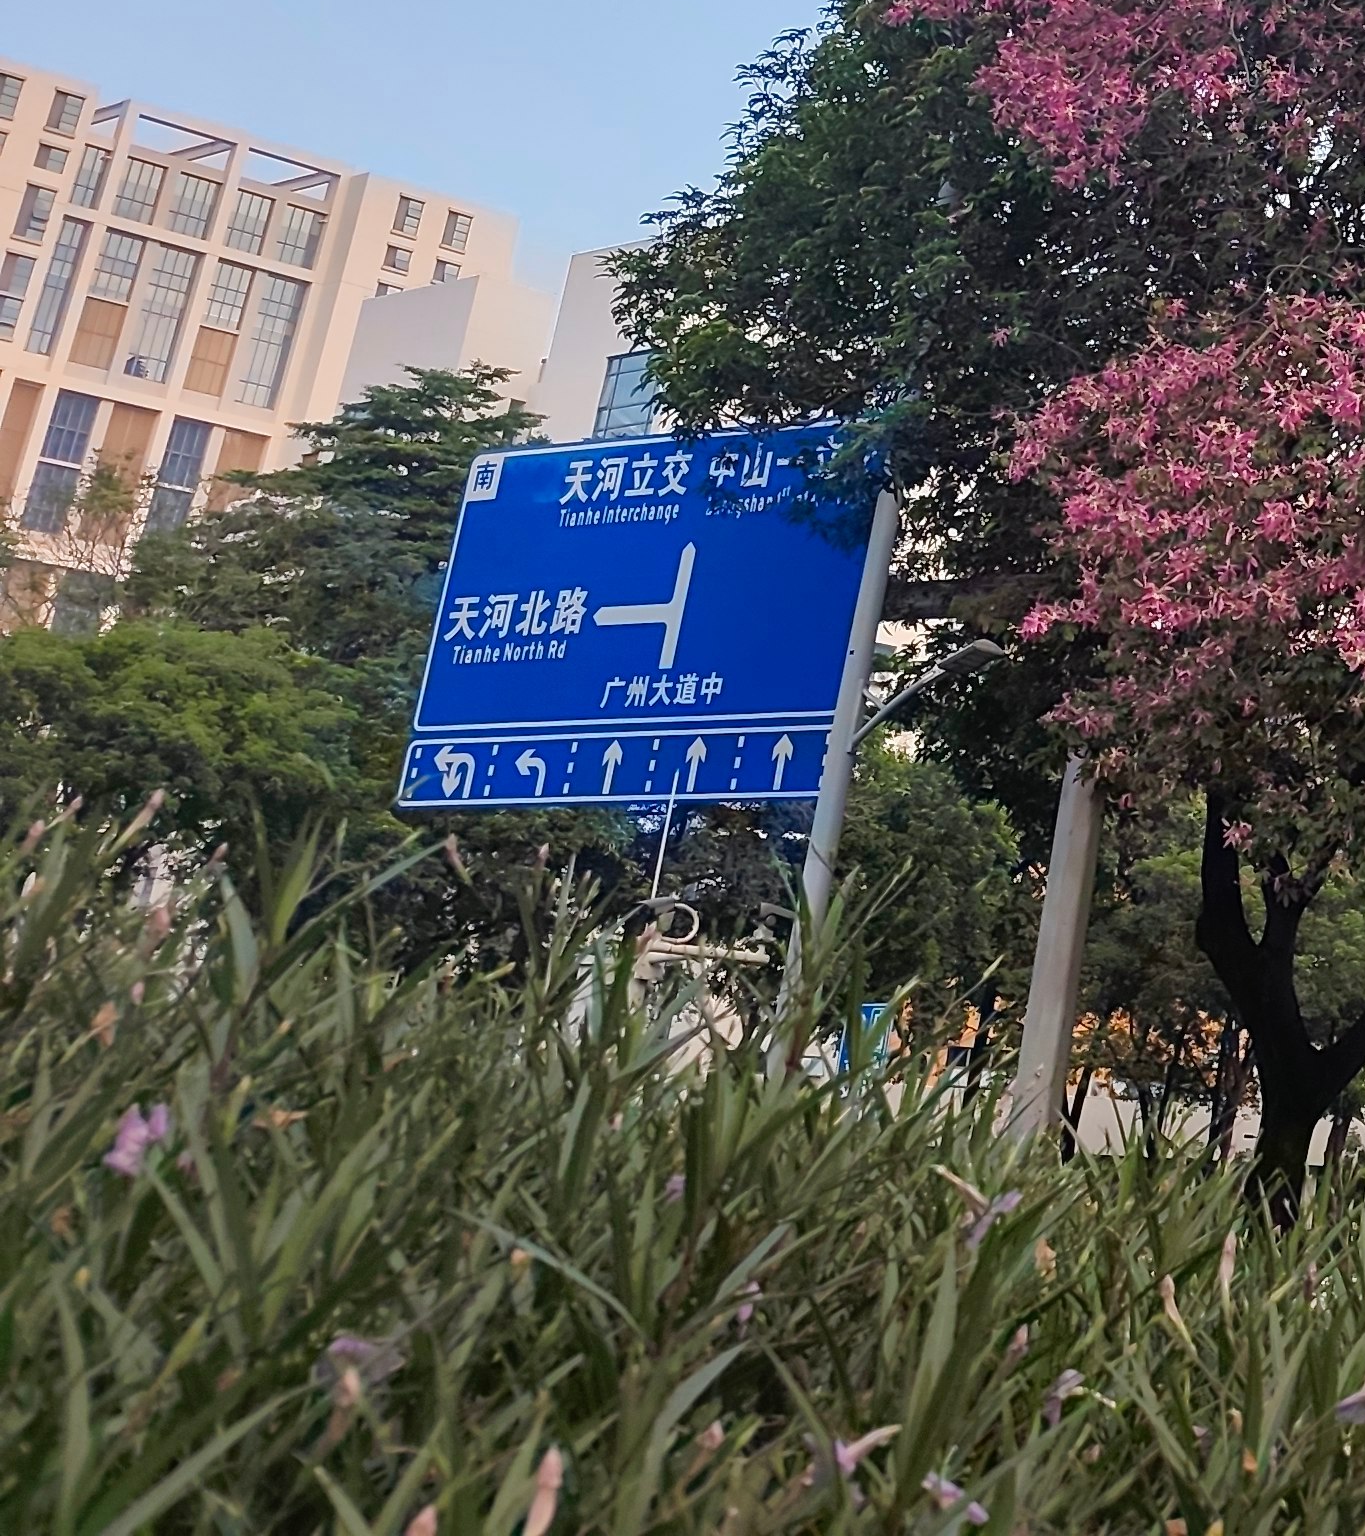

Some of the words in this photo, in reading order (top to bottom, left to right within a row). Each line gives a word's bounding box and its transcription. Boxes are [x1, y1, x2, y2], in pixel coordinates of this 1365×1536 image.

[472, 460, 498, 492] 南
[558, 449, 694, 506] 天河立交
[559, 506, 600, 528] Tianhe
[601, 502, 680, 526] Interchange
[443, 586, 589, 642] 天河北路
[452, 644, 500, 665] Tianhe
[502, 640, 544, 662] North
[547, 639, 567, 659] Rd
[599, 671, 724, 709] 广州大道中
